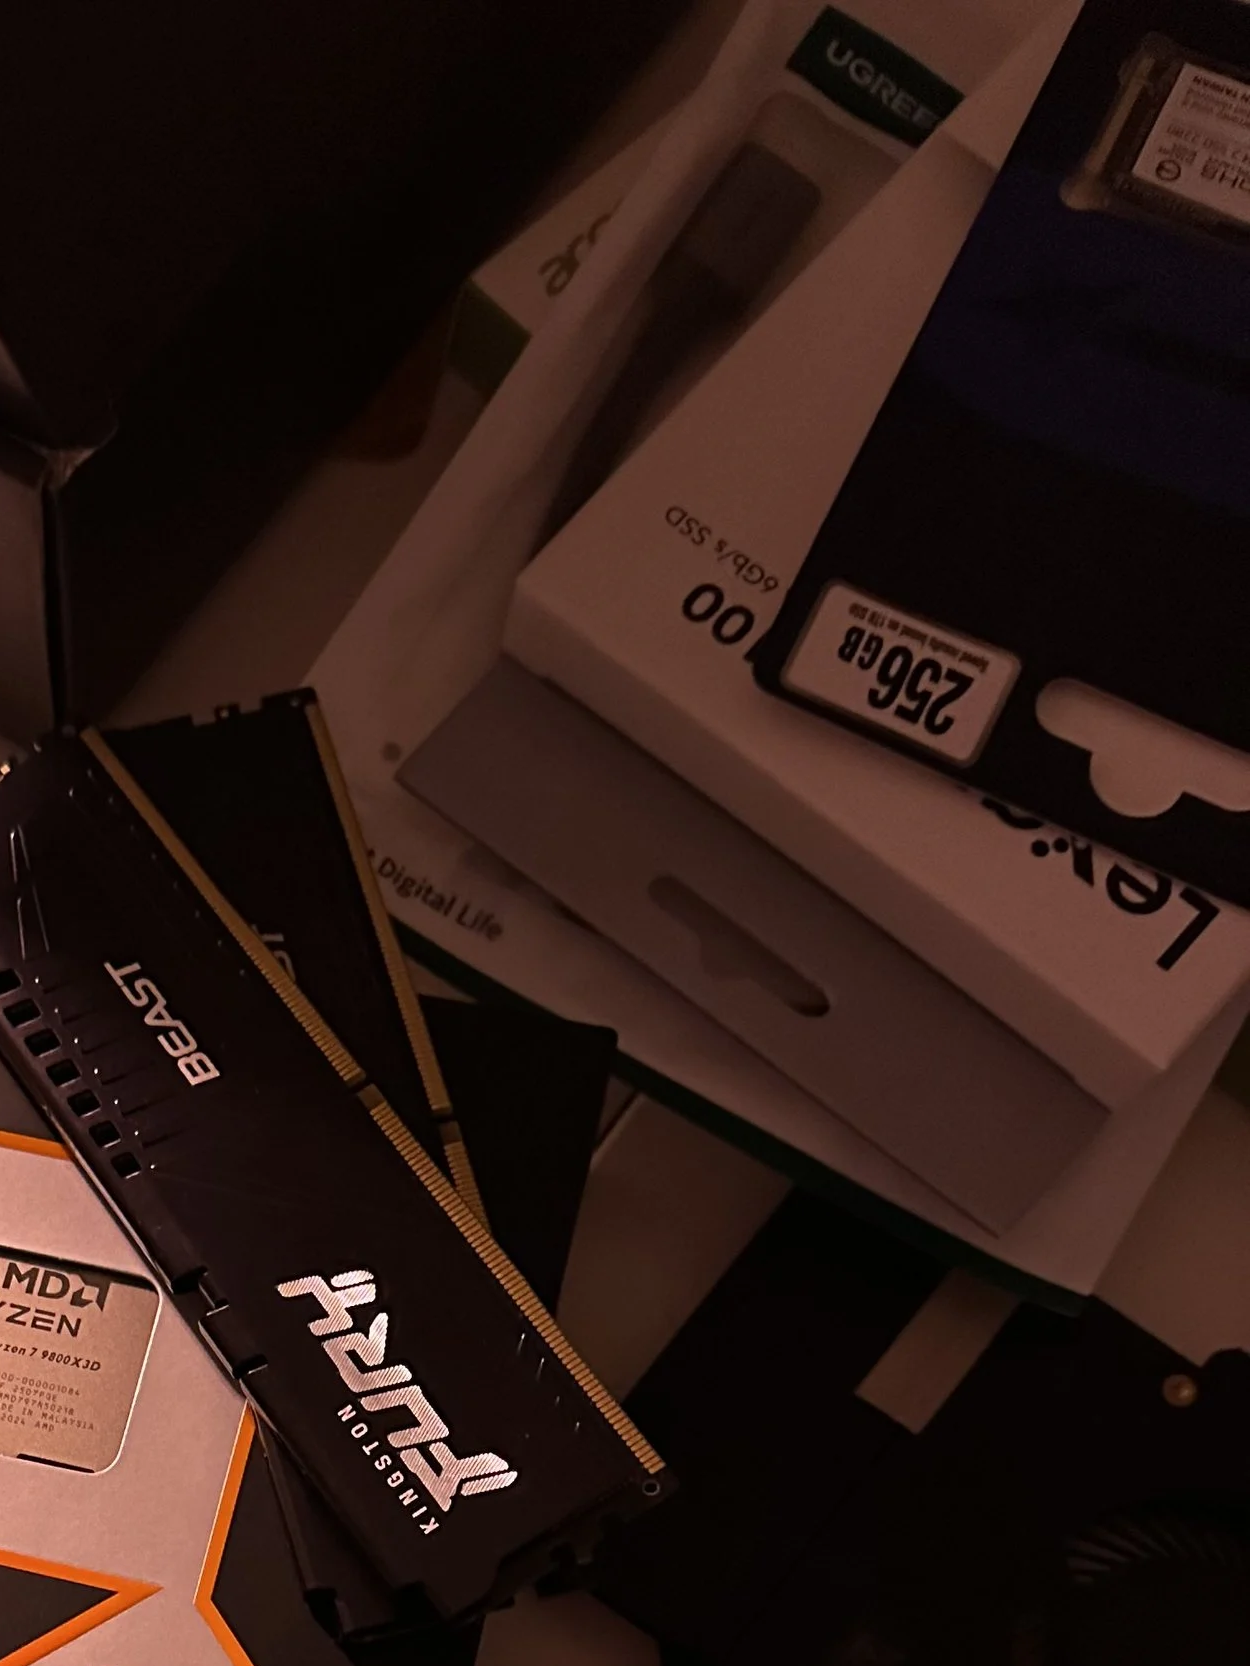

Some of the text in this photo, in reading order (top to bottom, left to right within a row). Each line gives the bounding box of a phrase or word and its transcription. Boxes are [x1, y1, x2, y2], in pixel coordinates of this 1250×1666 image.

[825, 39, 941, 128] UGREE
[665, 506, 779, 593] 6Gb/s SSD
[838, 626, 974, 735] 256 GB
[378, 857, 502, 942] Digital Life
[103, 961, 220, 1086] BEAST
[29, 1347, 38, 1357] 7
[41, 1350, 101, 1371] 9800X3D
[276, 1269, 518, 1512] FURY
[1, 1414, 26, 1426] 2024
[34, 1420, 55, 1432] AMD
[22, 1406, 33, 1415] IN
[41, 1410, 94, 1430] MALAYSIA
[337, 1404, 440, 1535] KINGSTON
